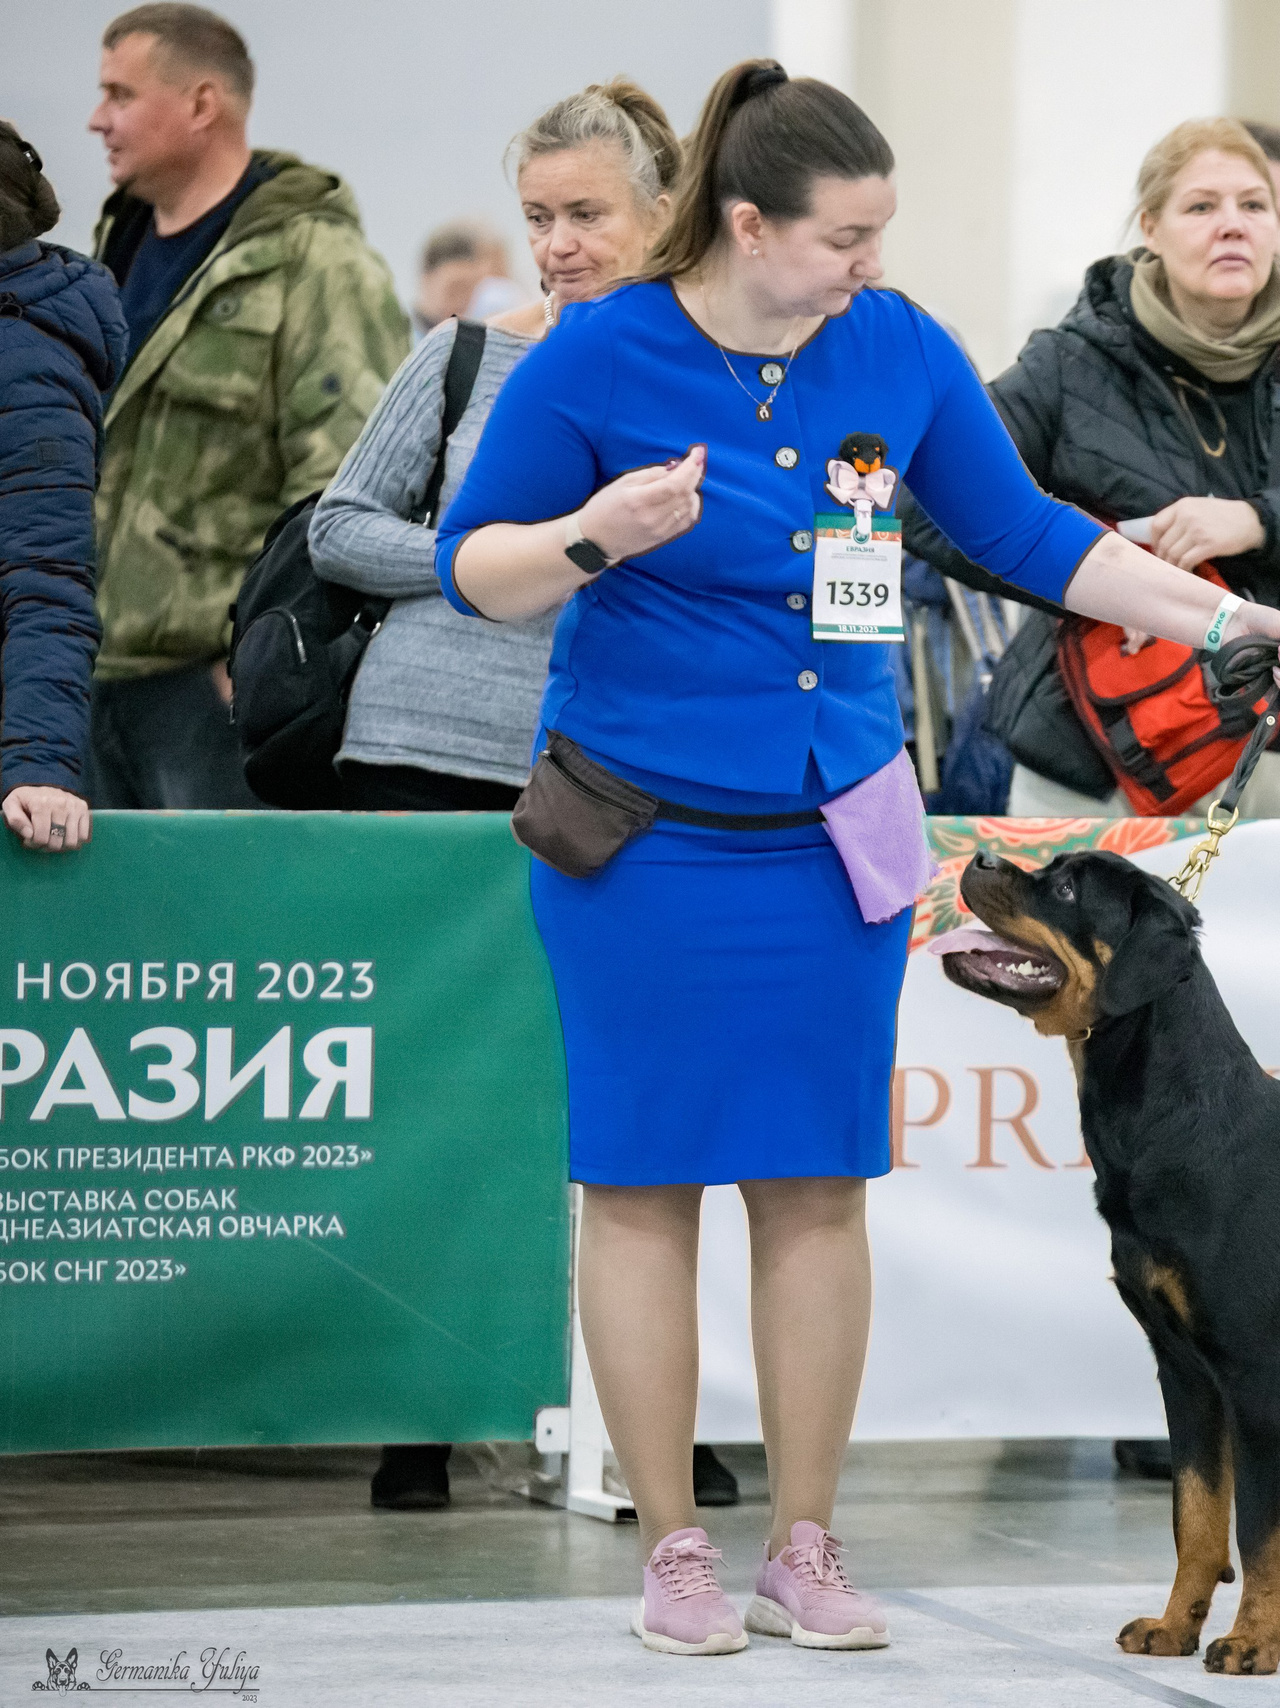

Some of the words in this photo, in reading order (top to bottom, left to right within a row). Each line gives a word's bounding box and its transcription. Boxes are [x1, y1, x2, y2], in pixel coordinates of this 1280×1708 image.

[826, 580, 890, 607] 1339
[838, 624, 879, 633] 18.11.2023
[17, 961, 235, 1000] НОЯБРЯ
[256, 961, 376, 1000] 2023
[57, 1146, 235, 1173] ПРЕЗИДЕНТА
[242, 1145, 296, 1168] РКФ
[302, 1145, 373, 1167] 2023»
[0, 1189, 137, 1212] ЫСТАВКА
[144, 1188, 237, 1212] СОБАК
[218, 1214, 345, 1238] ОВЧАРКА
[54, 1259, 109, 1283] СНГ
[115, 1259, 187, 1282] 2023»
